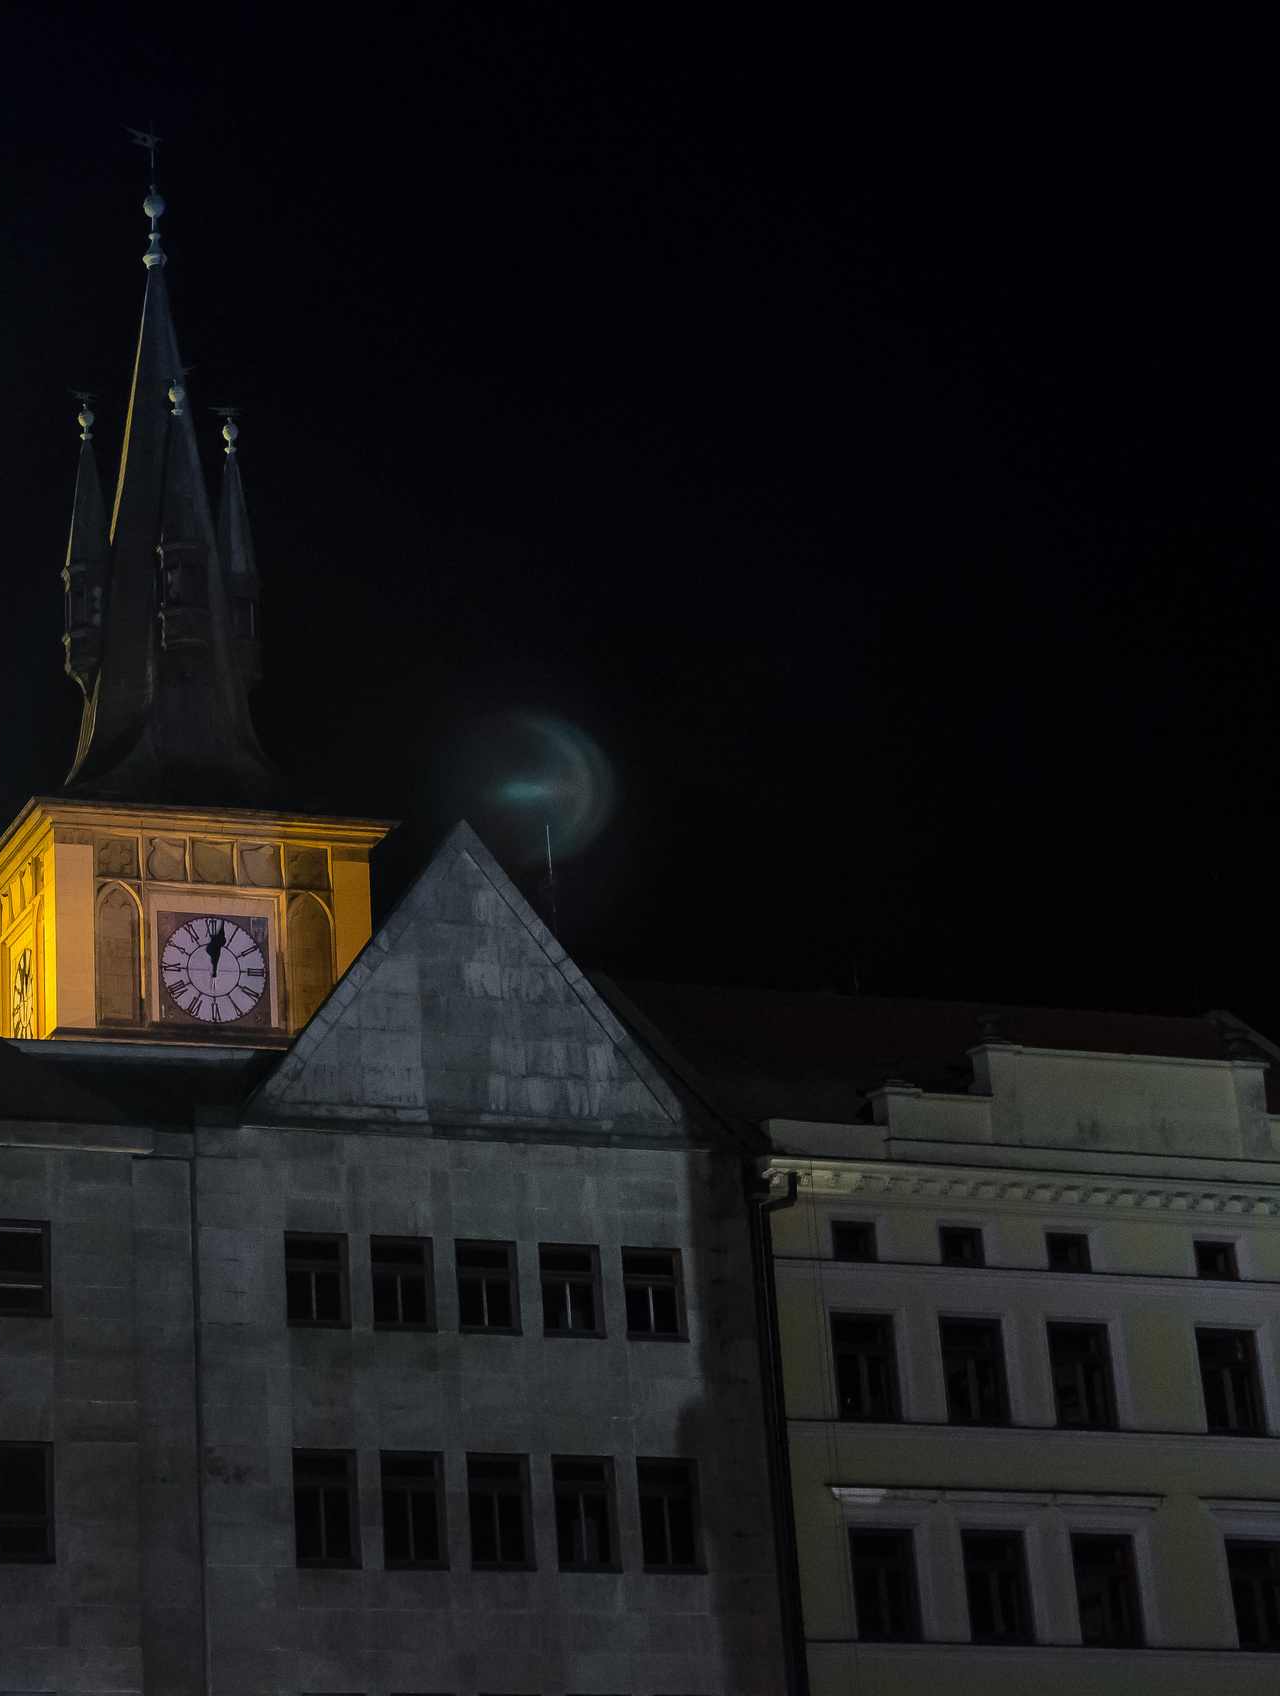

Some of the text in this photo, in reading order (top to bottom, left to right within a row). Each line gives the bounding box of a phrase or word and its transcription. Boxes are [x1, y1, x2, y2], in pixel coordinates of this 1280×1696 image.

[183, 922, 199, 943] XI
[205, 918, 217, 938] XII
[168, 941, 186, 954] X
[240, 945, 258, 957] II
[161, 962, 181, 973] IX
[247, 968, 265, 977] III
[211, 1002, 221, 1022] VI
